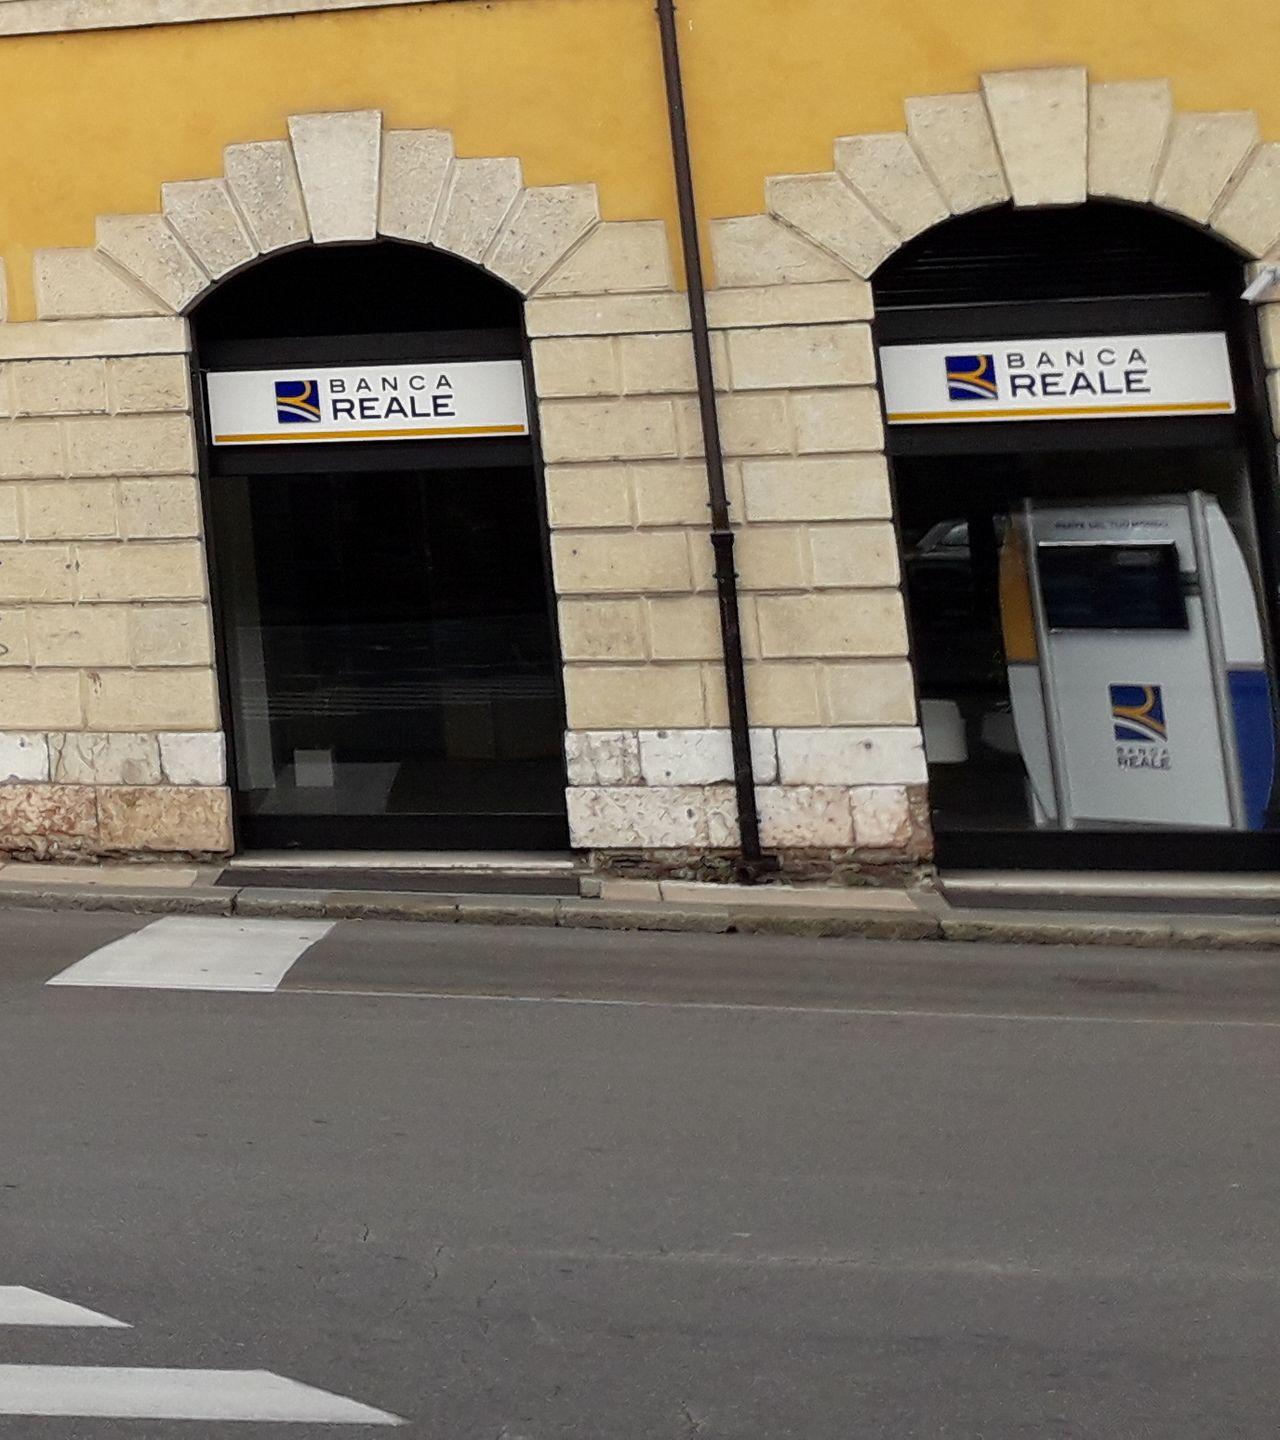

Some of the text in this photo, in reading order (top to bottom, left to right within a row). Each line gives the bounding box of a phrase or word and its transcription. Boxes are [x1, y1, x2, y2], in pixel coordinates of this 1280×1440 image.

[1006, 348, 1147, 369] BANCA
[329, 374, 453, 394] BANCA
[1009, 369, 1151, 398] REALE
[331, 394, 456, 421] REALE
